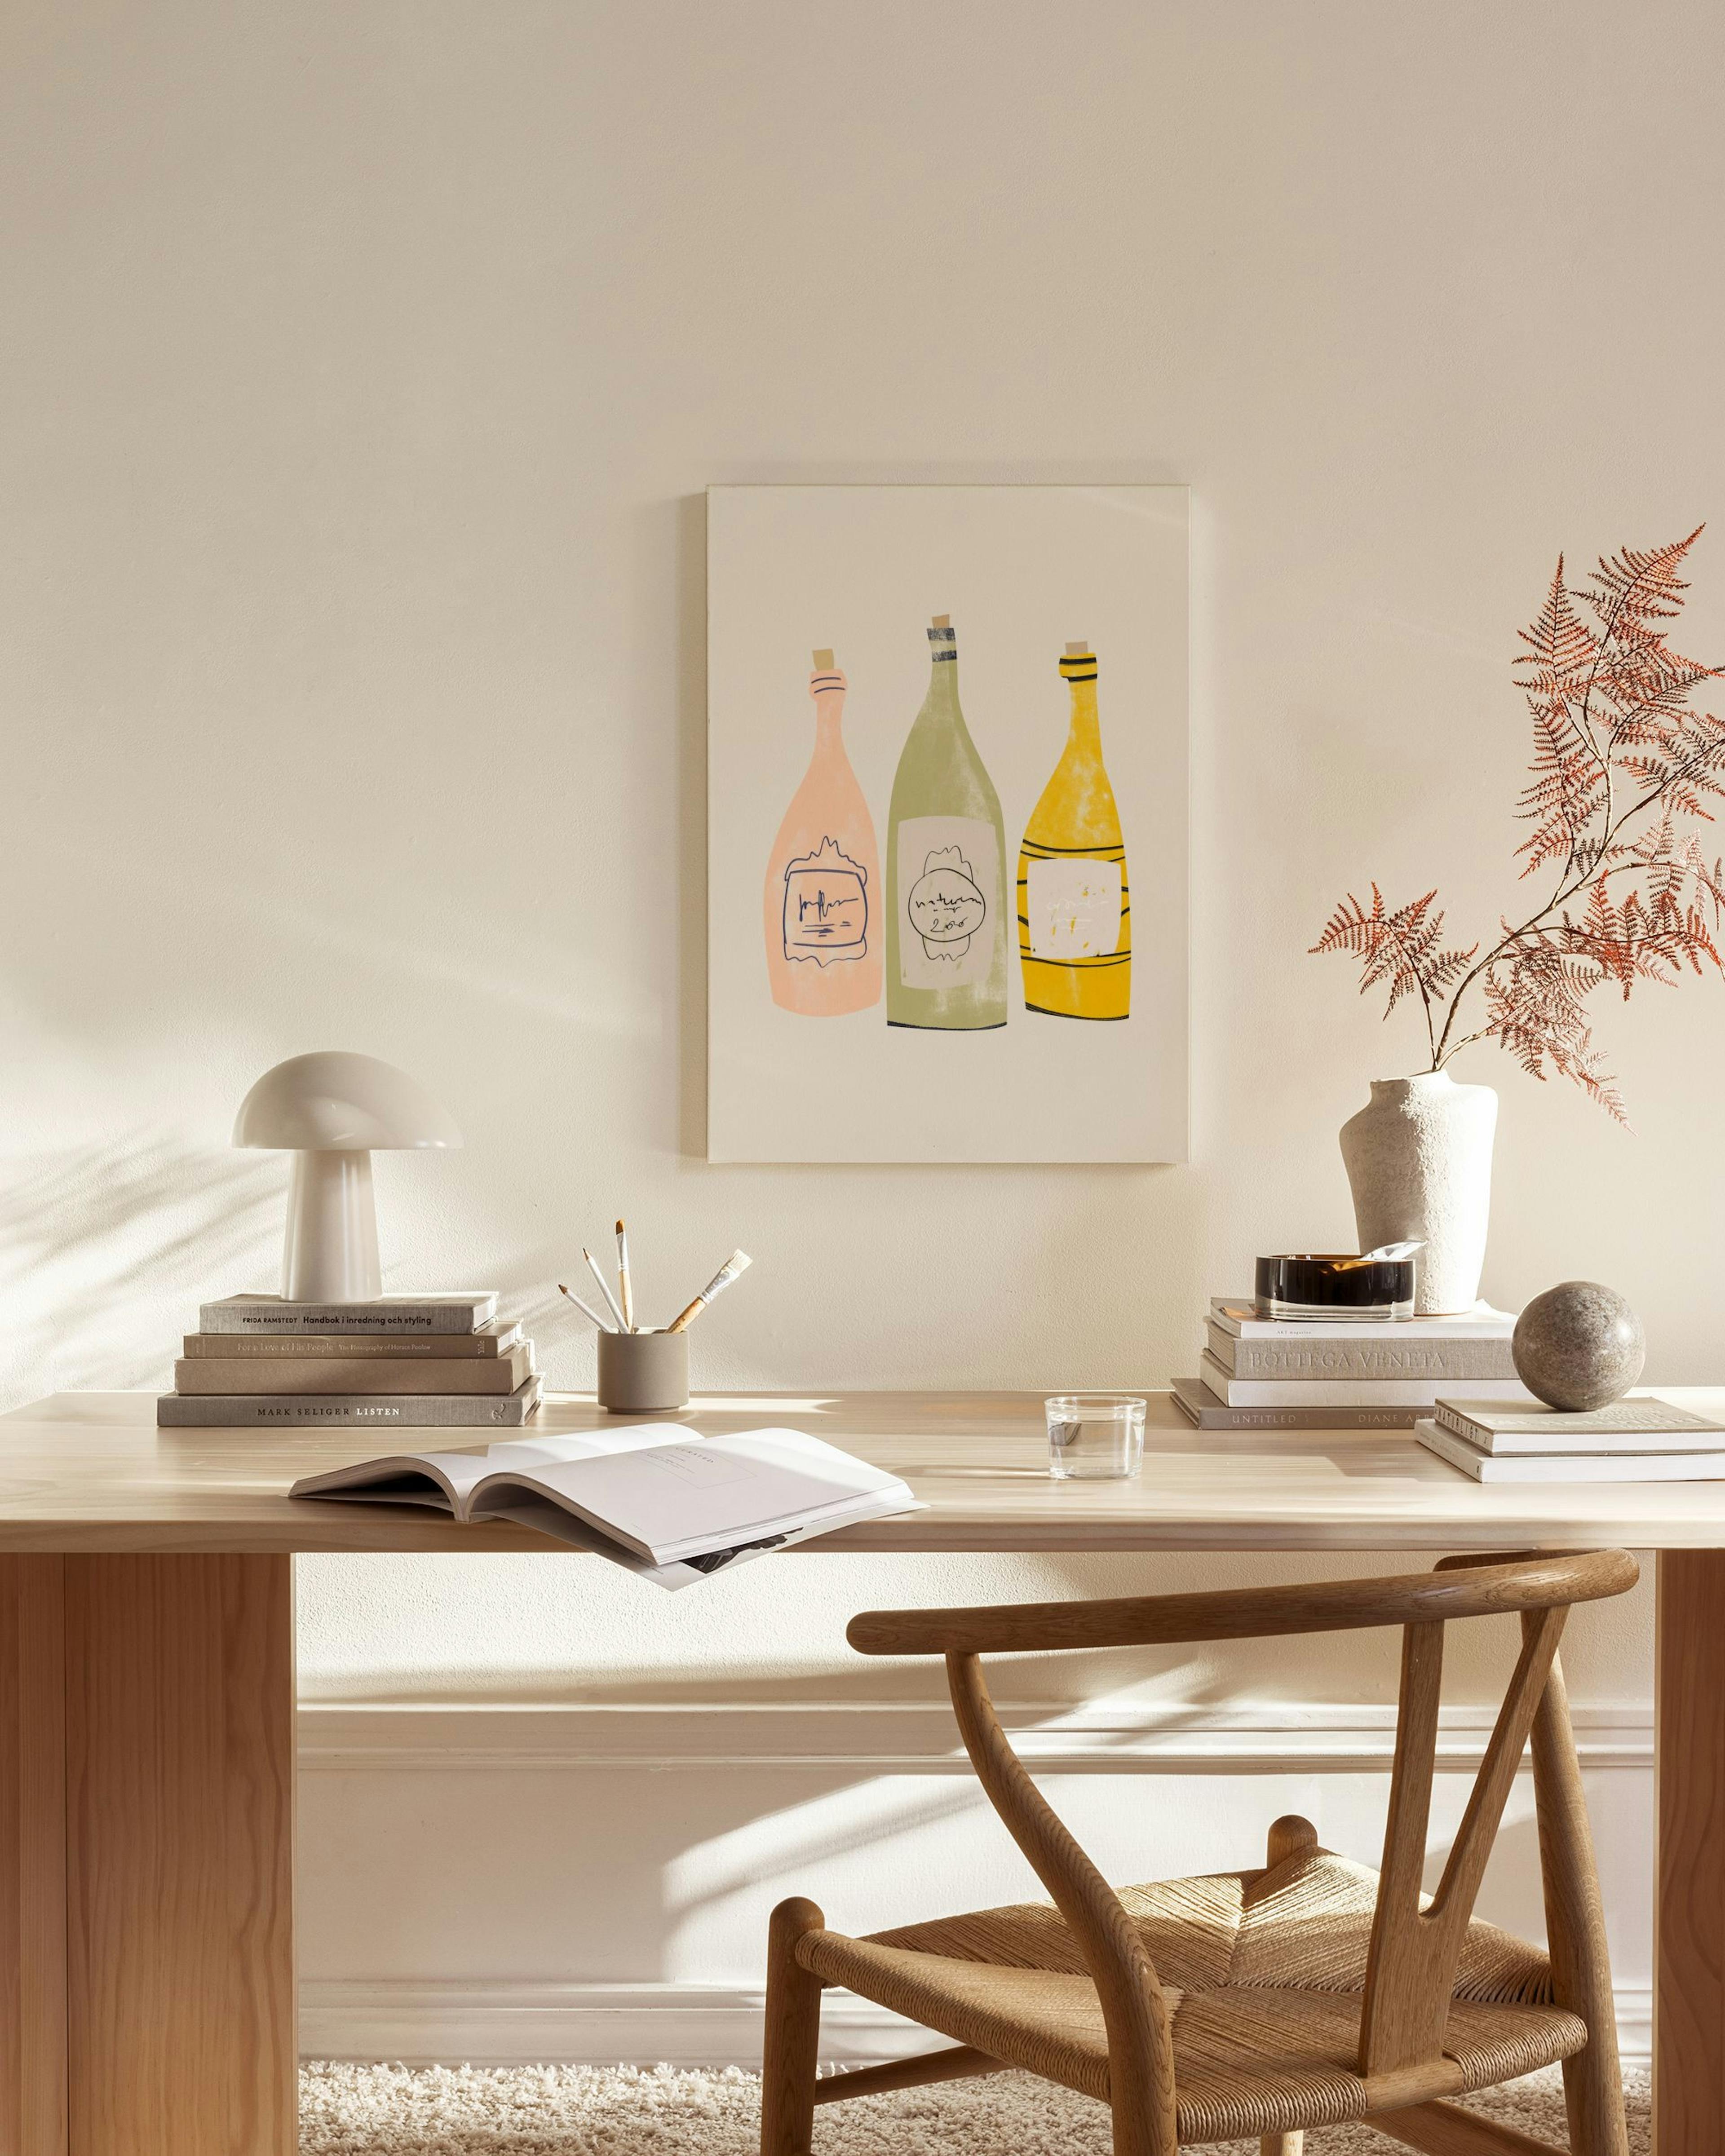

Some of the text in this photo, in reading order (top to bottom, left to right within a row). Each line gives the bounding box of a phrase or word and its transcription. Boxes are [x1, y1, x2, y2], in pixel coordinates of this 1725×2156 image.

[346, 1317, 385, 1325] inredning
[404, 1317, 432, 1325] styling
[1250, 1352, 1445, 1368] BOTTEGA VENETA
[1232, 1415, 1296, 1423] UNTITLED
[1358, 1414, 1398, 1423] DIANE
